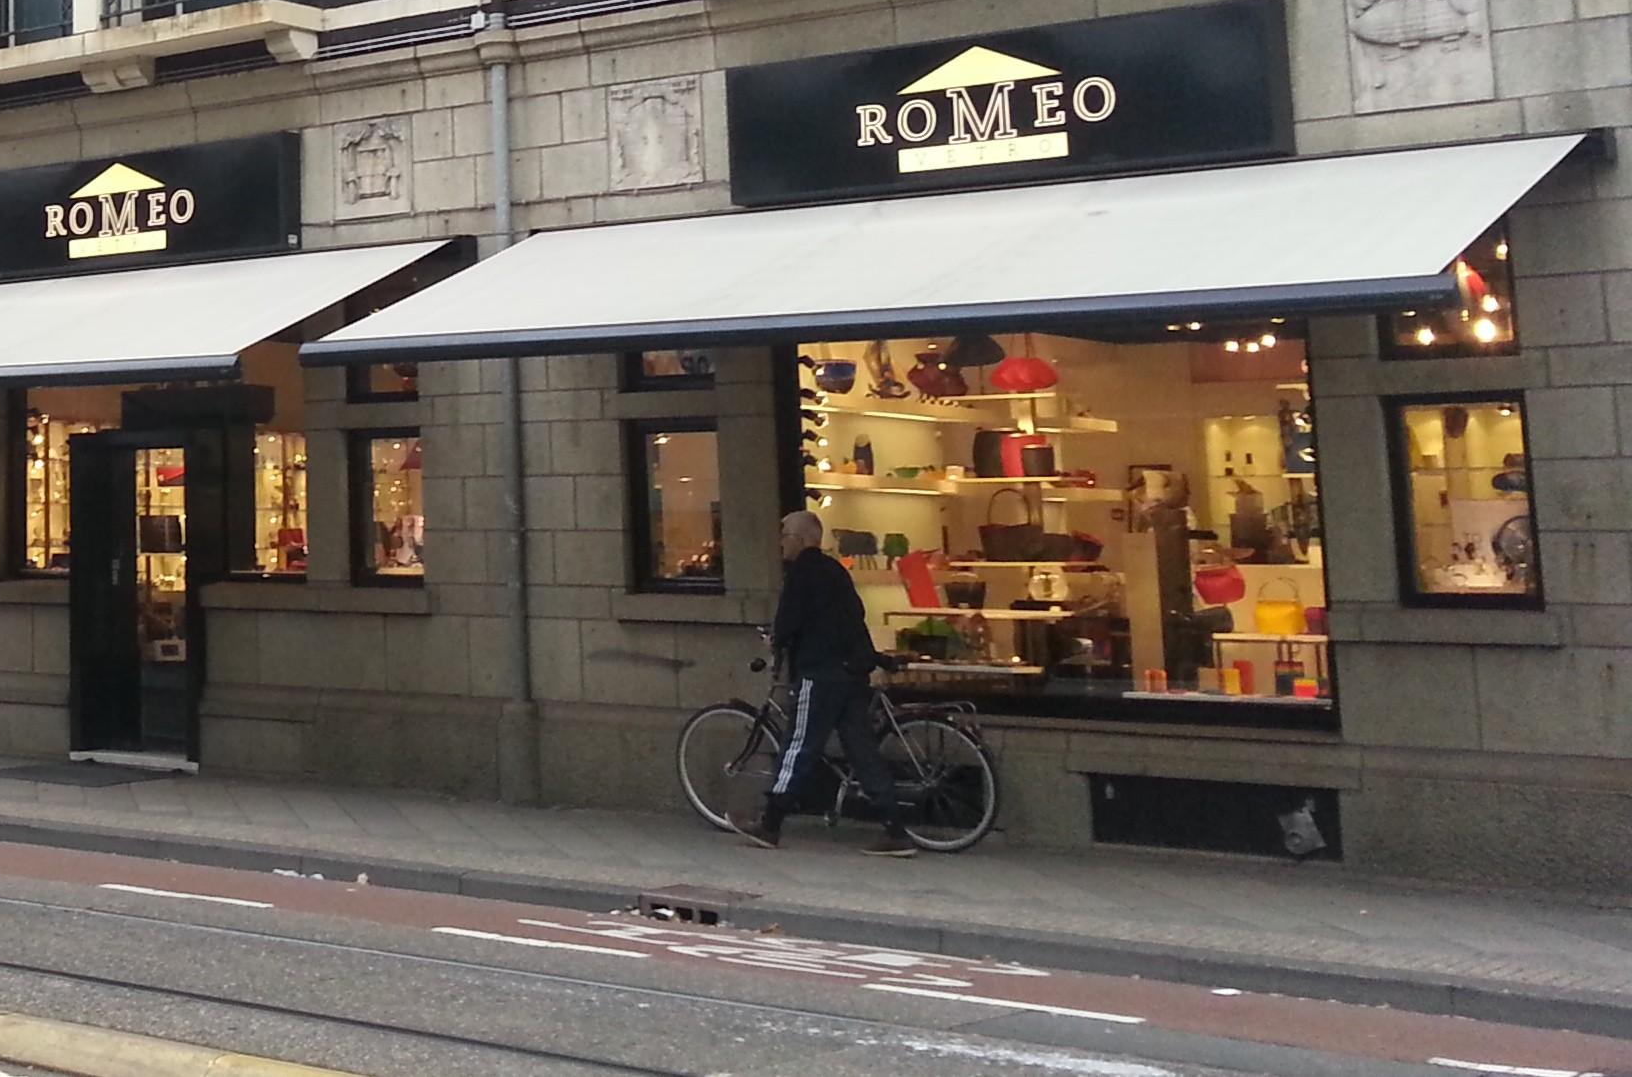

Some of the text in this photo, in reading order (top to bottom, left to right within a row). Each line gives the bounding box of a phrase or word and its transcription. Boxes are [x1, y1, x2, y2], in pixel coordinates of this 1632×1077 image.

[856, 76, 1117, 147] ROMEO
[915, 138, 1052, 167] VETRO
[45, 189, 195, 238] ROMEO
